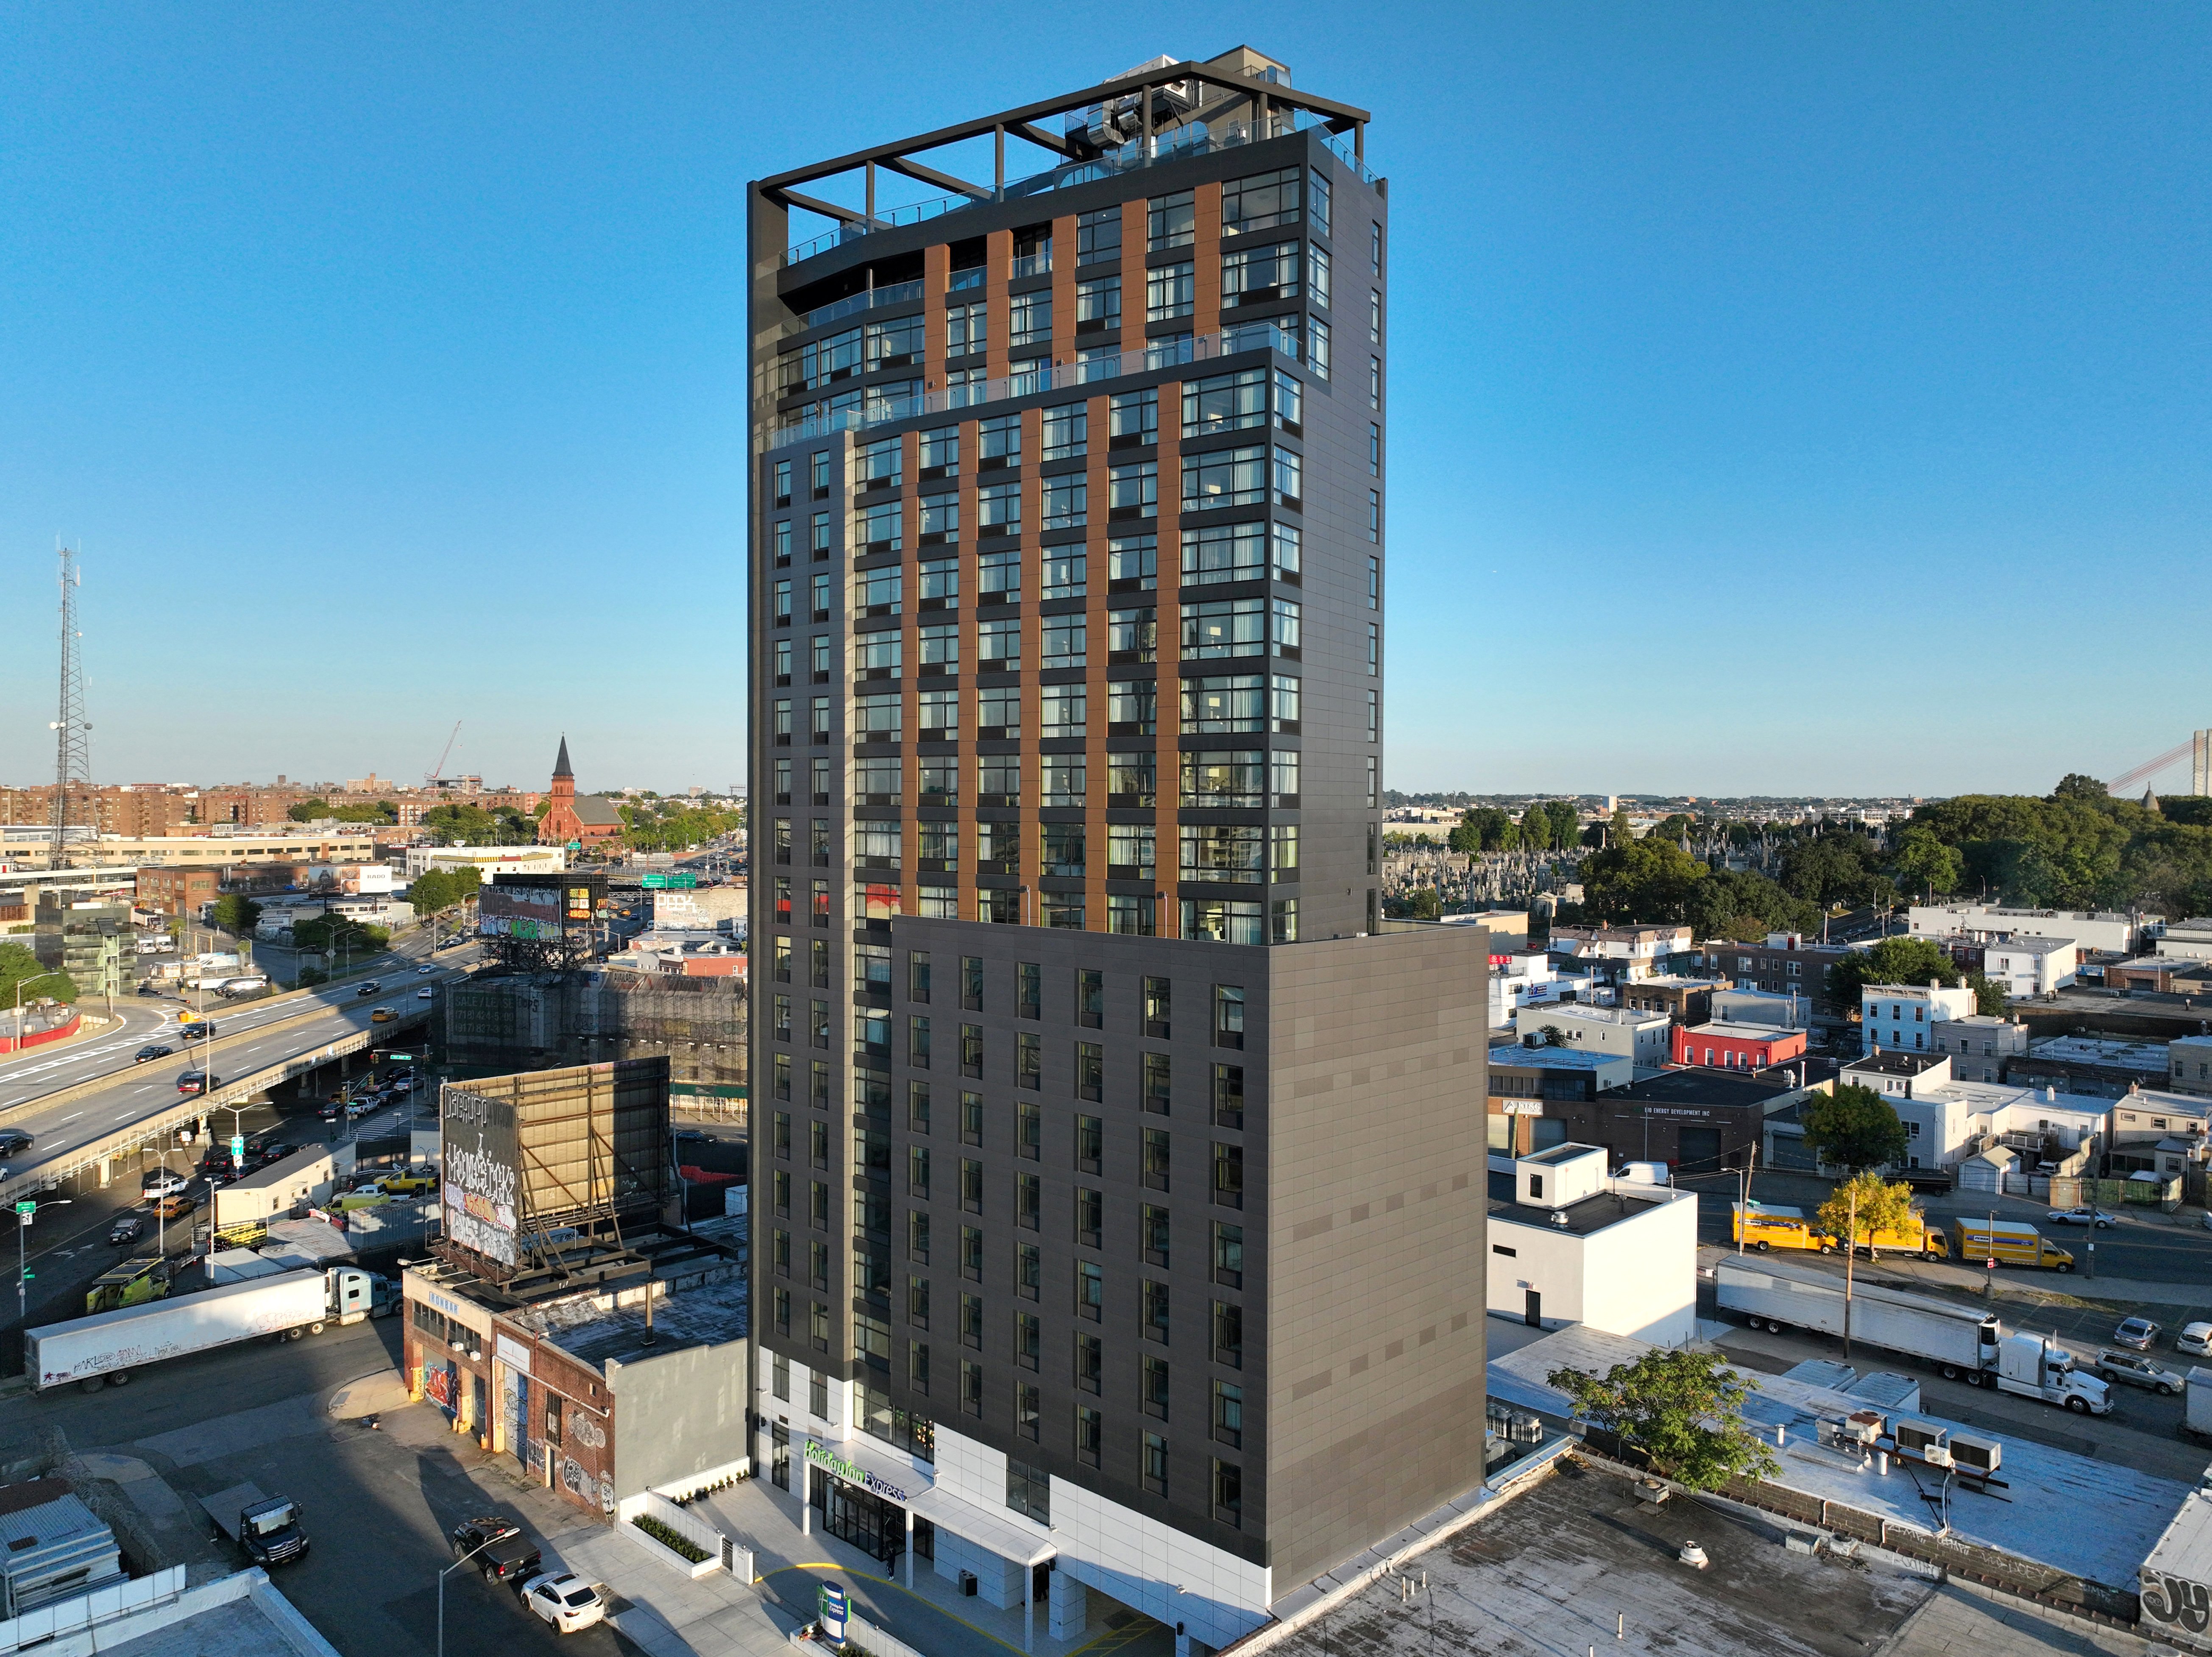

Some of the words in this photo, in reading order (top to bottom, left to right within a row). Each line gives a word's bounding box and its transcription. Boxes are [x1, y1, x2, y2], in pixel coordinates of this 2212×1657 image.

[455, 996, 478, 1007] SALE
[485, 997, 514, 1009] LESE
[476, 1011, 514, 1022] 424-500
[803, 1440, 846, 1477] Holiday
[845, 1462, 864, 1484] Inn
[864, 1472, 905, 1502] Express
[829, 1605, 844, 1615] Express
